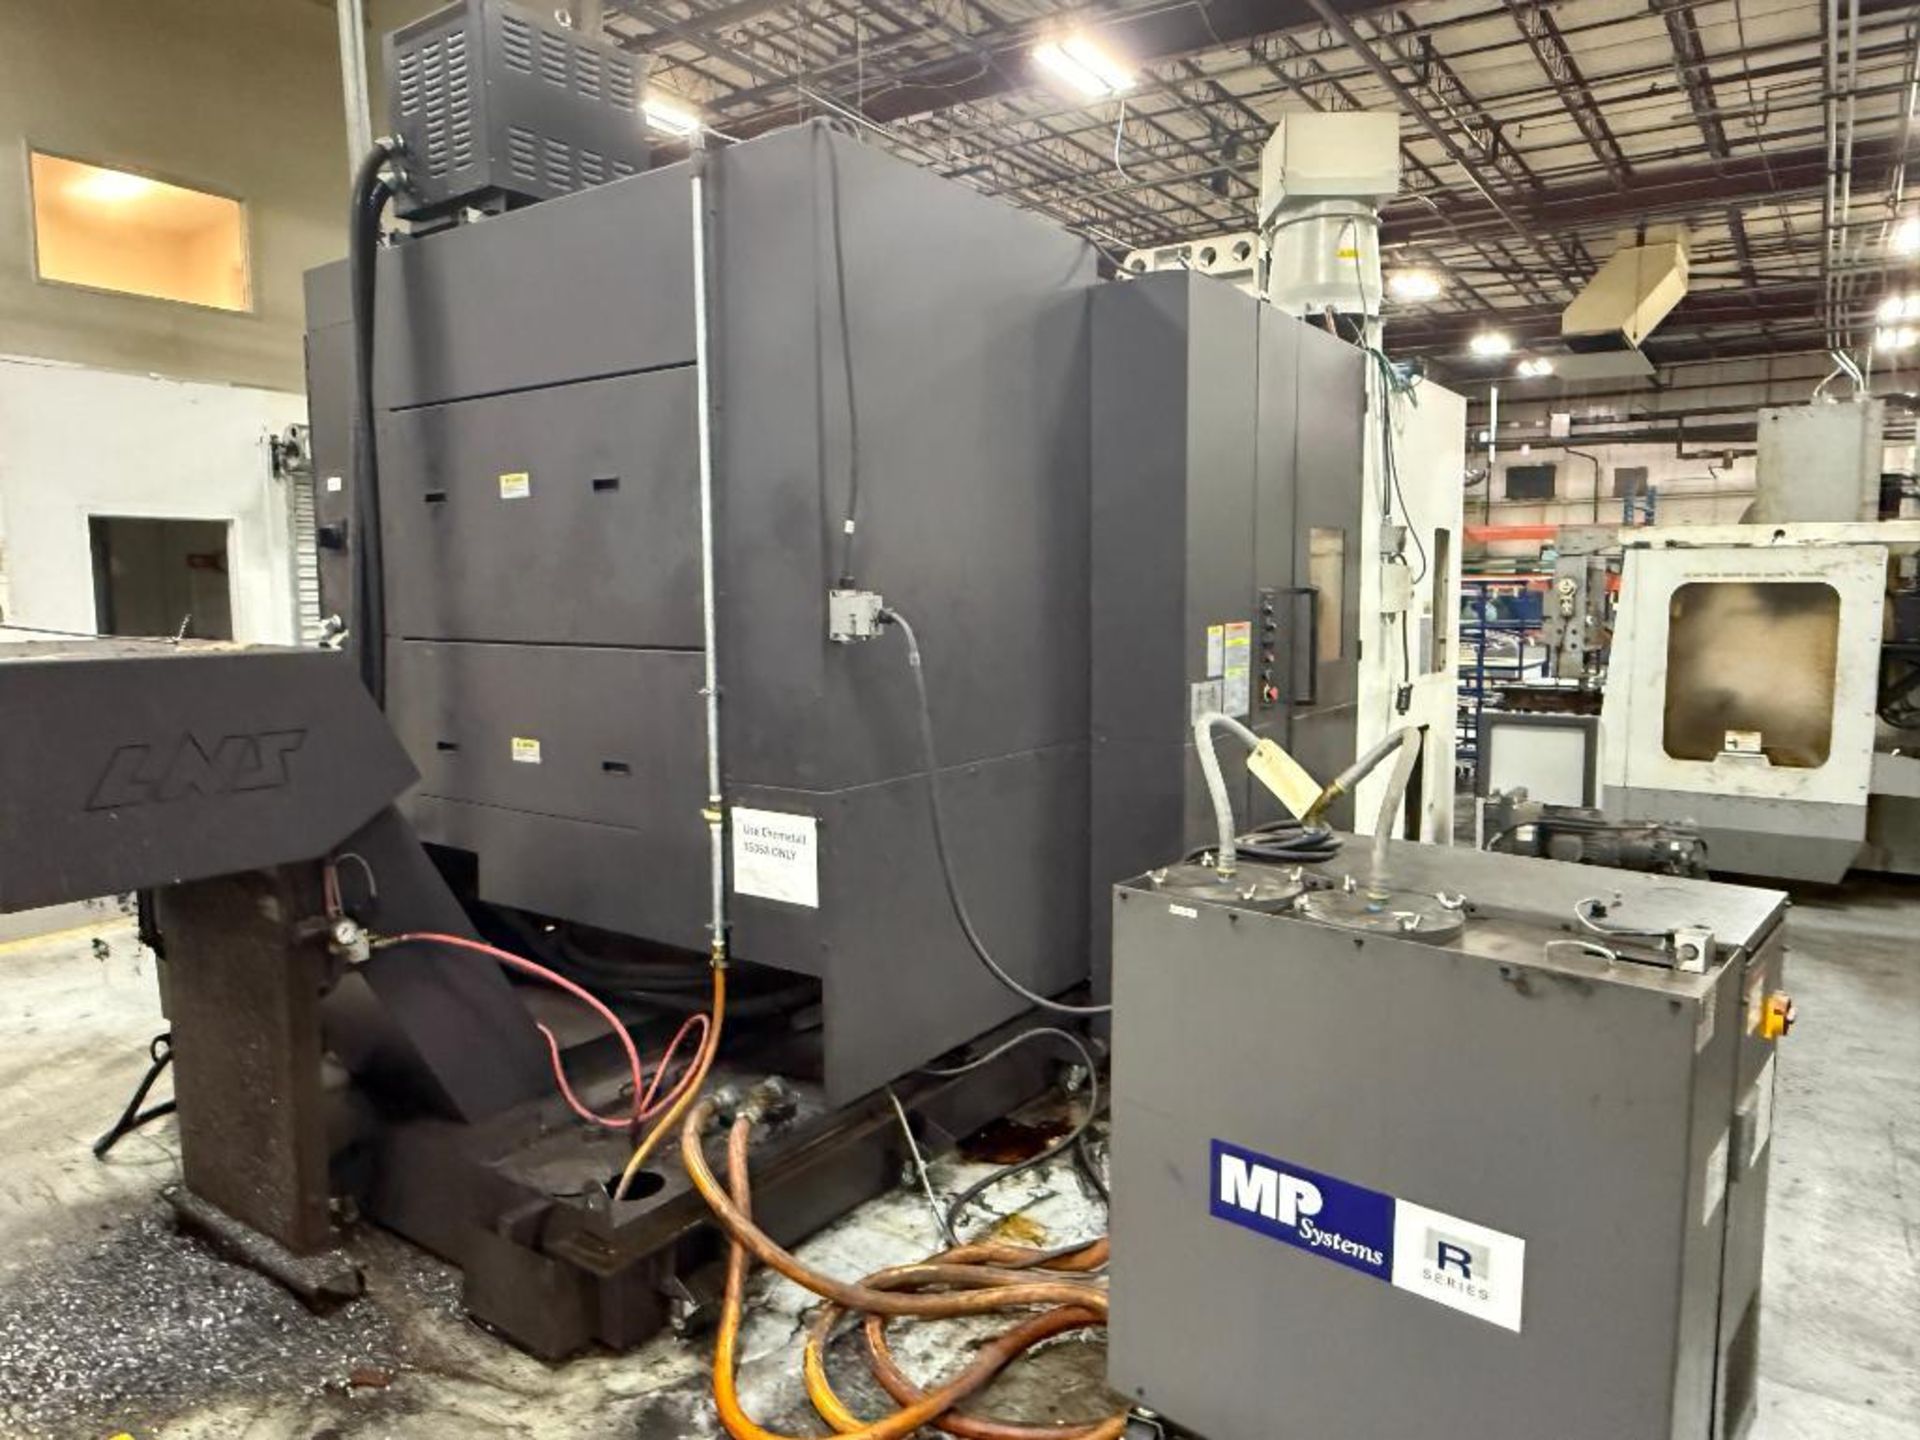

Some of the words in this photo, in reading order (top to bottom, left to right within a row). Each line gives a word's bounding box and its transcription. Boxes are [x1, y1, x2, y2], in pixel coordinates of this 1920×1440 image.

[743, 824, 759, 837] Use
[771, 847, 797, 861] ONLY
[1220, 1153, 1323, 1227] MP
[1299, 1218, 1384, 1266] Systems
[1437, 1240, 1473, 1280] R
[1422, 1268, 1490, 1301] SERIES
